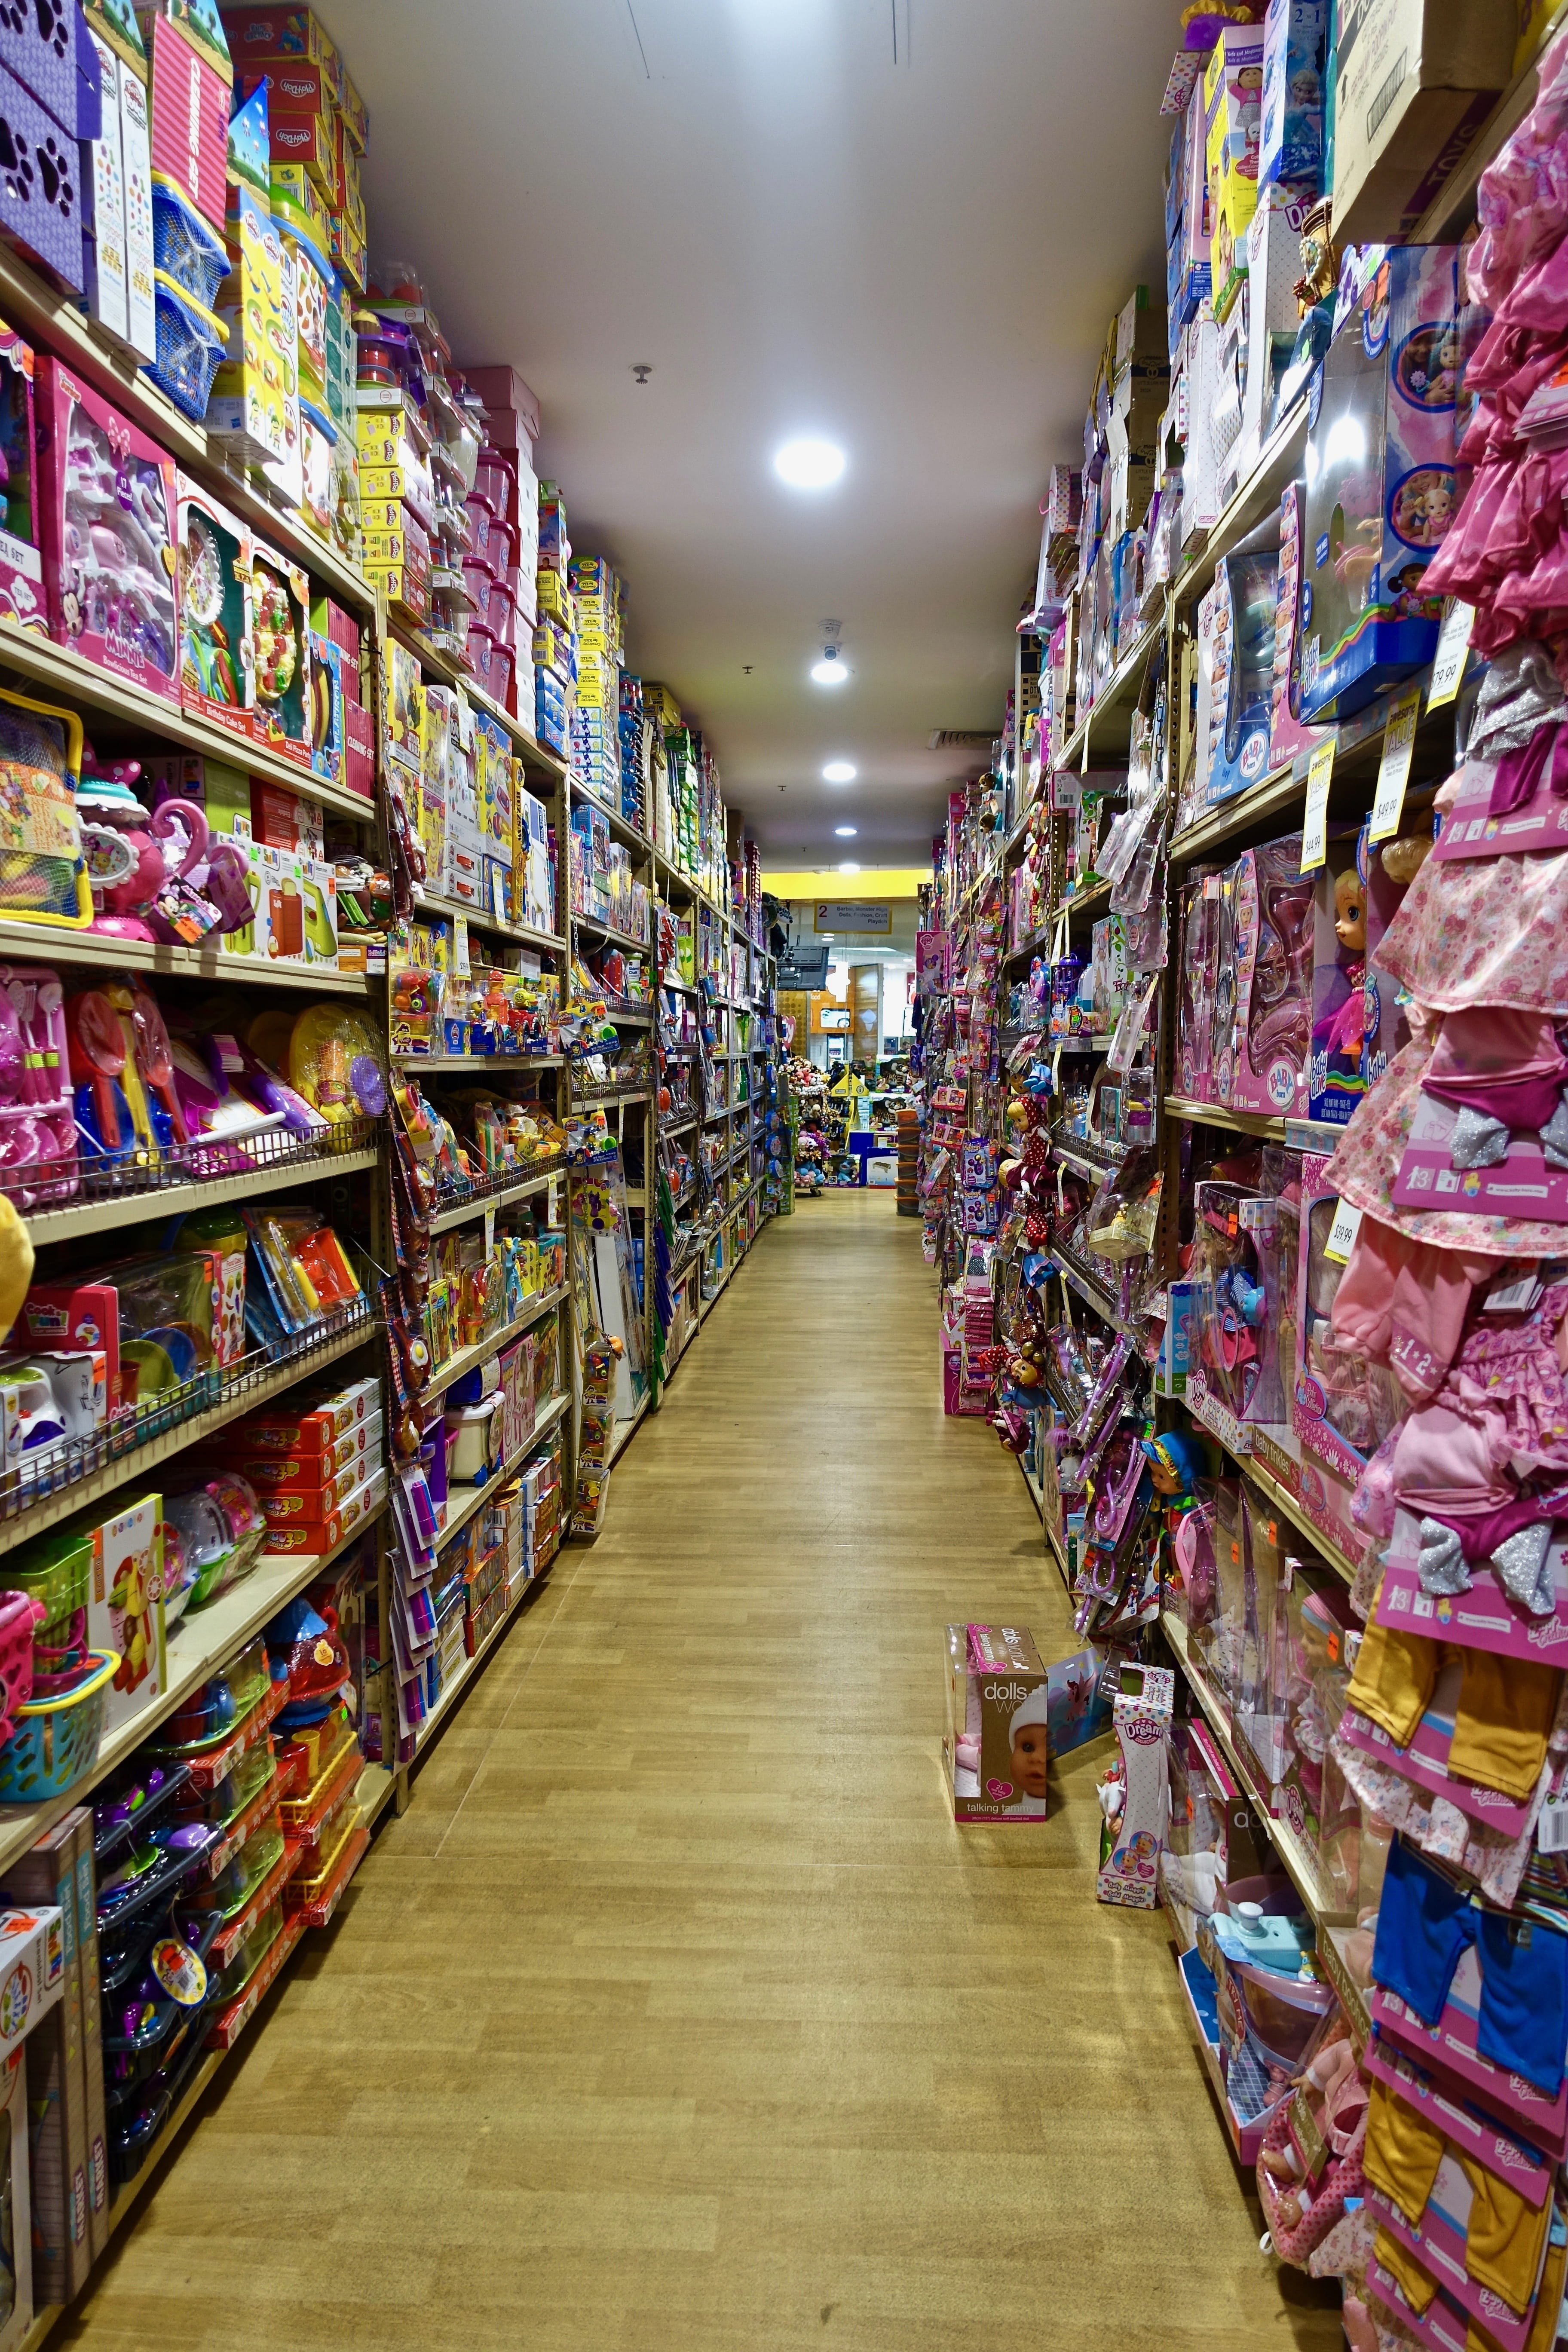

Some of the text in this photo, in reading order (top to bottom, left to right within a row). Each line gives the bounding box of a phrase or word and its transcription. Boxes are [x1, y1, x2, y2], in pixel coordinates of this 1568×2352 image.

[1294, 9, 1303, 23] 2
[282, 81, 315, 94] Play-Doh
[188, 57, 201, 201] CLEANING SET
[278, 132, 310, 144] Play-Doh
[1427, 124, 1477, 187] TOYS
[390, 414, 398, 435] Play-Doh
[385, 440, 394, 462] Play-Doh
[120, 477, 127, 489] 17
[390, 471, 398, 493] Play-Doh
[387, 504, 396, 526] Play-Doh
[11, 550, 24, 566] SET
[390, 536, 398, 558] Play-Doh
[388, 572, 396, 594] Play-Doh
[13, 586, 34, 603] TEA SET
[350, 657, 359, 671] SET
[130, 668, 139, 680] Tea
[138, 674, 148, 685] Set
[1432, 663, 1456, 689] $79.99
[206, 705, 226, 723] Birthday
[226, 715, 238, 729] Cake
[237, 720, 247, 733] Set
[331, 679, 340, 743] FLATIRON
[1389, 701, 1416, 725] awesome
[347, 735, 376, 761] CLEANING SET
[407, 731, 419, 747] STAR
[1241, 740, 1265, 768] BABY
[1311, 752, 1332, 773] awesome
[1376, 797, 1398, 820] $49.99
[1305, 836, 1321, 856] $44.99
[819, 905, 828, 918] 2
[1311, 1050, 1328, 1077] baby
[1367, 1050, 1387, 1086] baby
[1270, 1068, 1293, 1094] BABY
[1311, 1072, 1327, 1099] alive
[1276, 1090, 1286, 1099] born
[1334, 1223, 1353, 1243] $39.99
[1415, 1353, 1432, 1376] 2
[1255, 1429, 1289, 1475] baby tinkles
[980, 1633, 995, 1661] talking tammy
[984, 1682, 1027, 1700] dolls
[1125, 1722, 1162, 1739] Dream
[967, 1803, 1033, 1814] talking tammy
[1227, 1977, 1239, 2004] TRY
[93, 2141, 105, 2208] MARKET
[74, 2171, 85, 2239] MARKET
